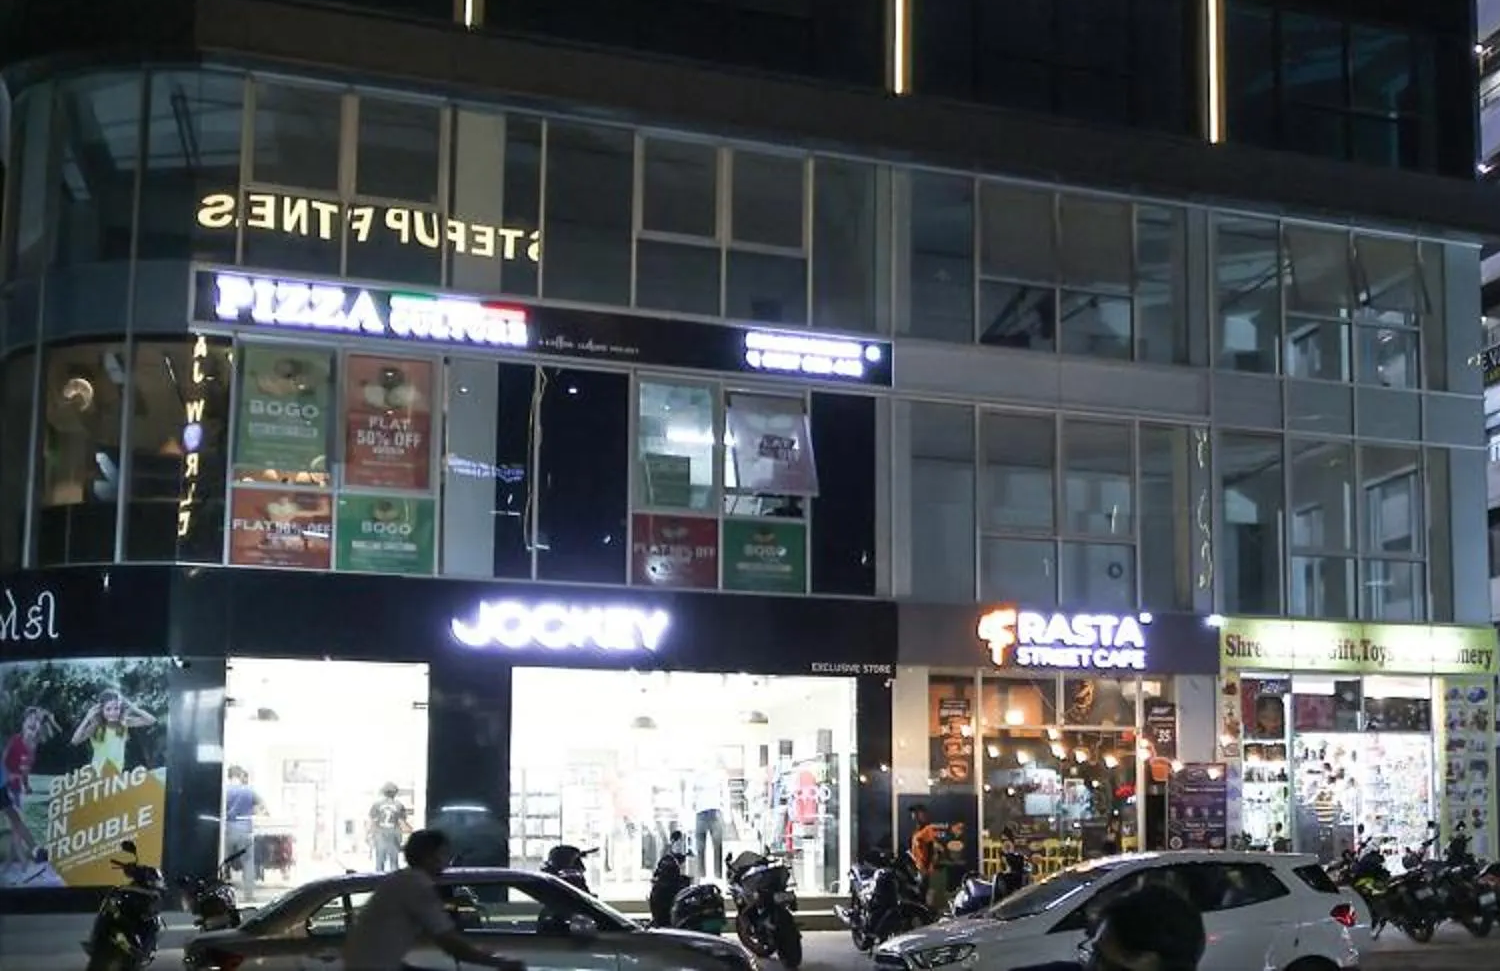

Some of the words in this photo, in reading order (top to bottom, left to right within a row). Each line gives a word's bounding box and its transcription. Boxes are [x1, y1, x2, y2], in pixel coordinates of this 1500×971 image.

[215, 274, 386, 334] PIZZA
[250, 399, 319, 418] BOGO
[369, 415, 412, 431] FLAT
[394, 431, 422, 448] OFF
[451, 600, 669, 652] JOCKEY
[1017, 611, 1145, 647] RASTA
[862, 663, 892, 675] STORE
[1016, 647, 1092, 667] STREET
[47, 764, 148, 819] GETTING
[49, 763, 103, 798] BUSY
[46, 815, 68, 842] IN
[47, 805, 154, 861] TROUBLE
